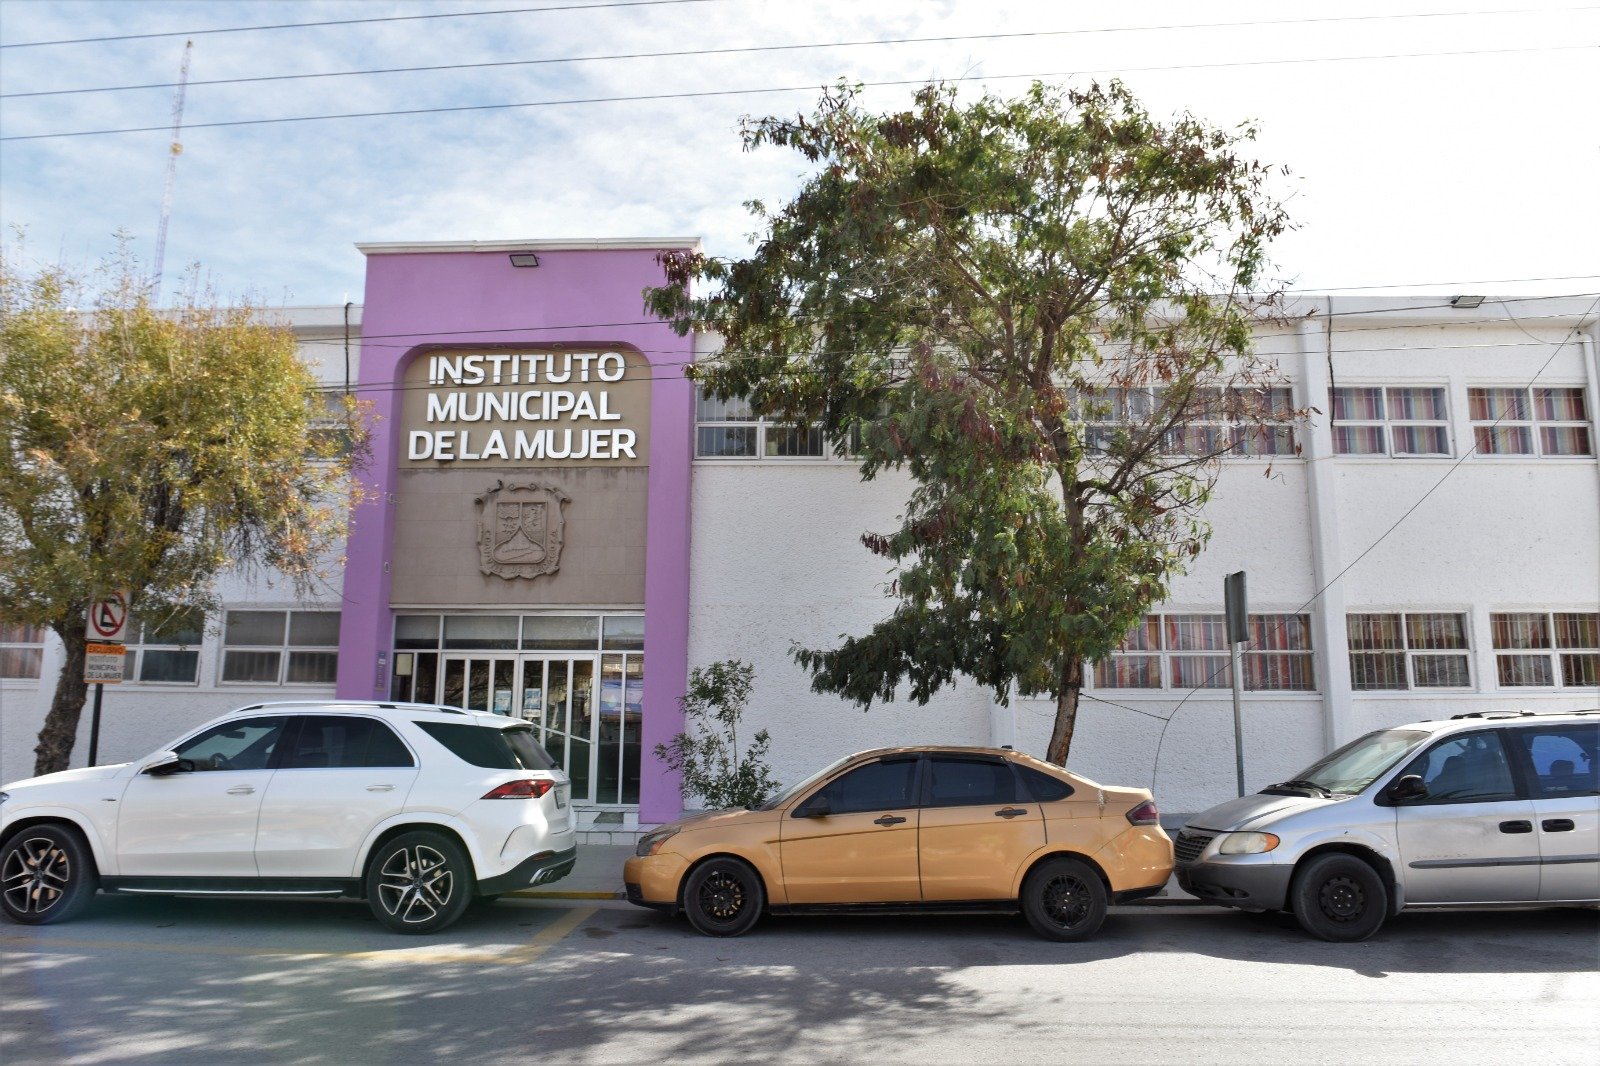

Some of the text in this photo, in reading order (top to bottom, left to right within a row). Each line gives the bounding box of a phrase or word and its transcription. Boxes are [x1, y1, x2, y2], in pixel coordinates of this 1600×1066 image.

[429, 352, 625, 384] INSTITUTO
[427, 391, 621, 422] MUNICIPAL
[408, 428, 636, 460] DE LA MUJER
